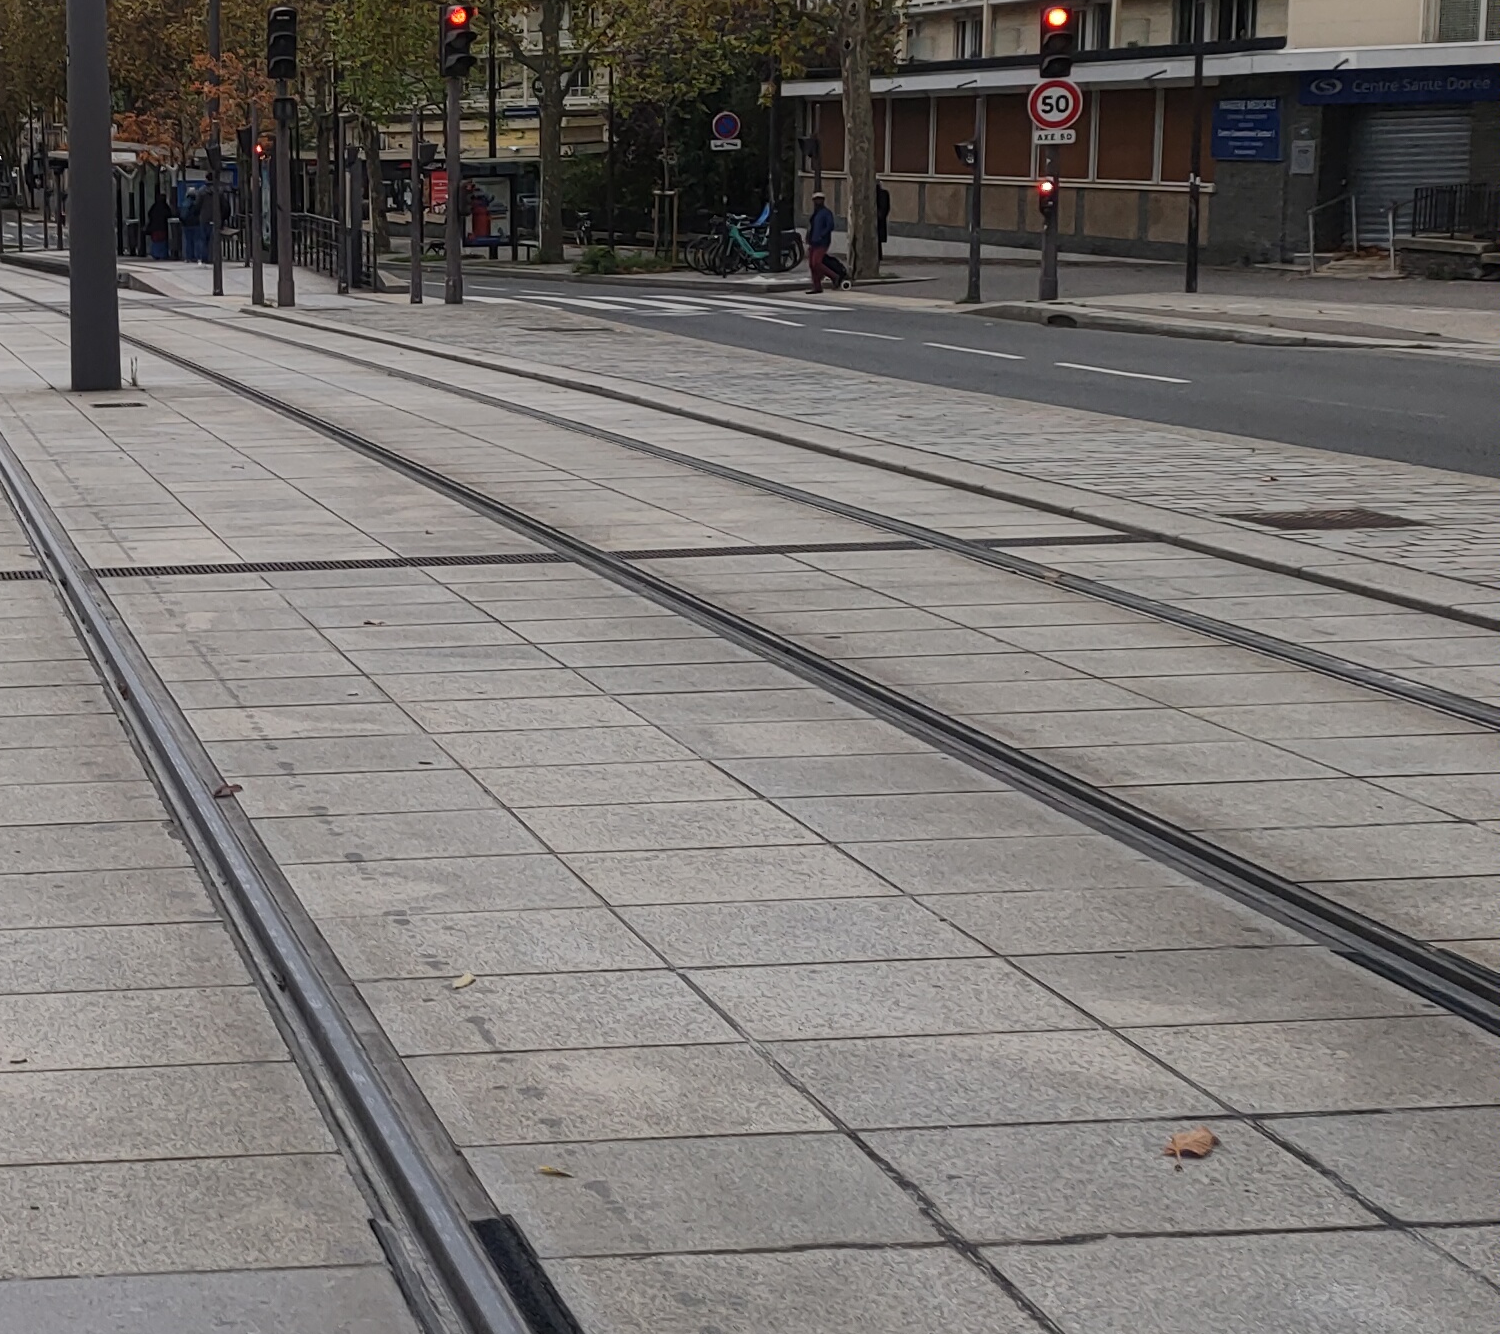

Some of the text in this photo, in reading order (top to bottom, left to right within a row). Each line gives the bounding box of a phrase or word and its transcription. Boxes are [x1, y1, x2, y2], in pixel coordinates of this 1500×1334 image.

[1352, 79, 1399, 93] Centre
[1041, 95, 1069, 114] 50
[1037, 133, 1056, 141] AXE
